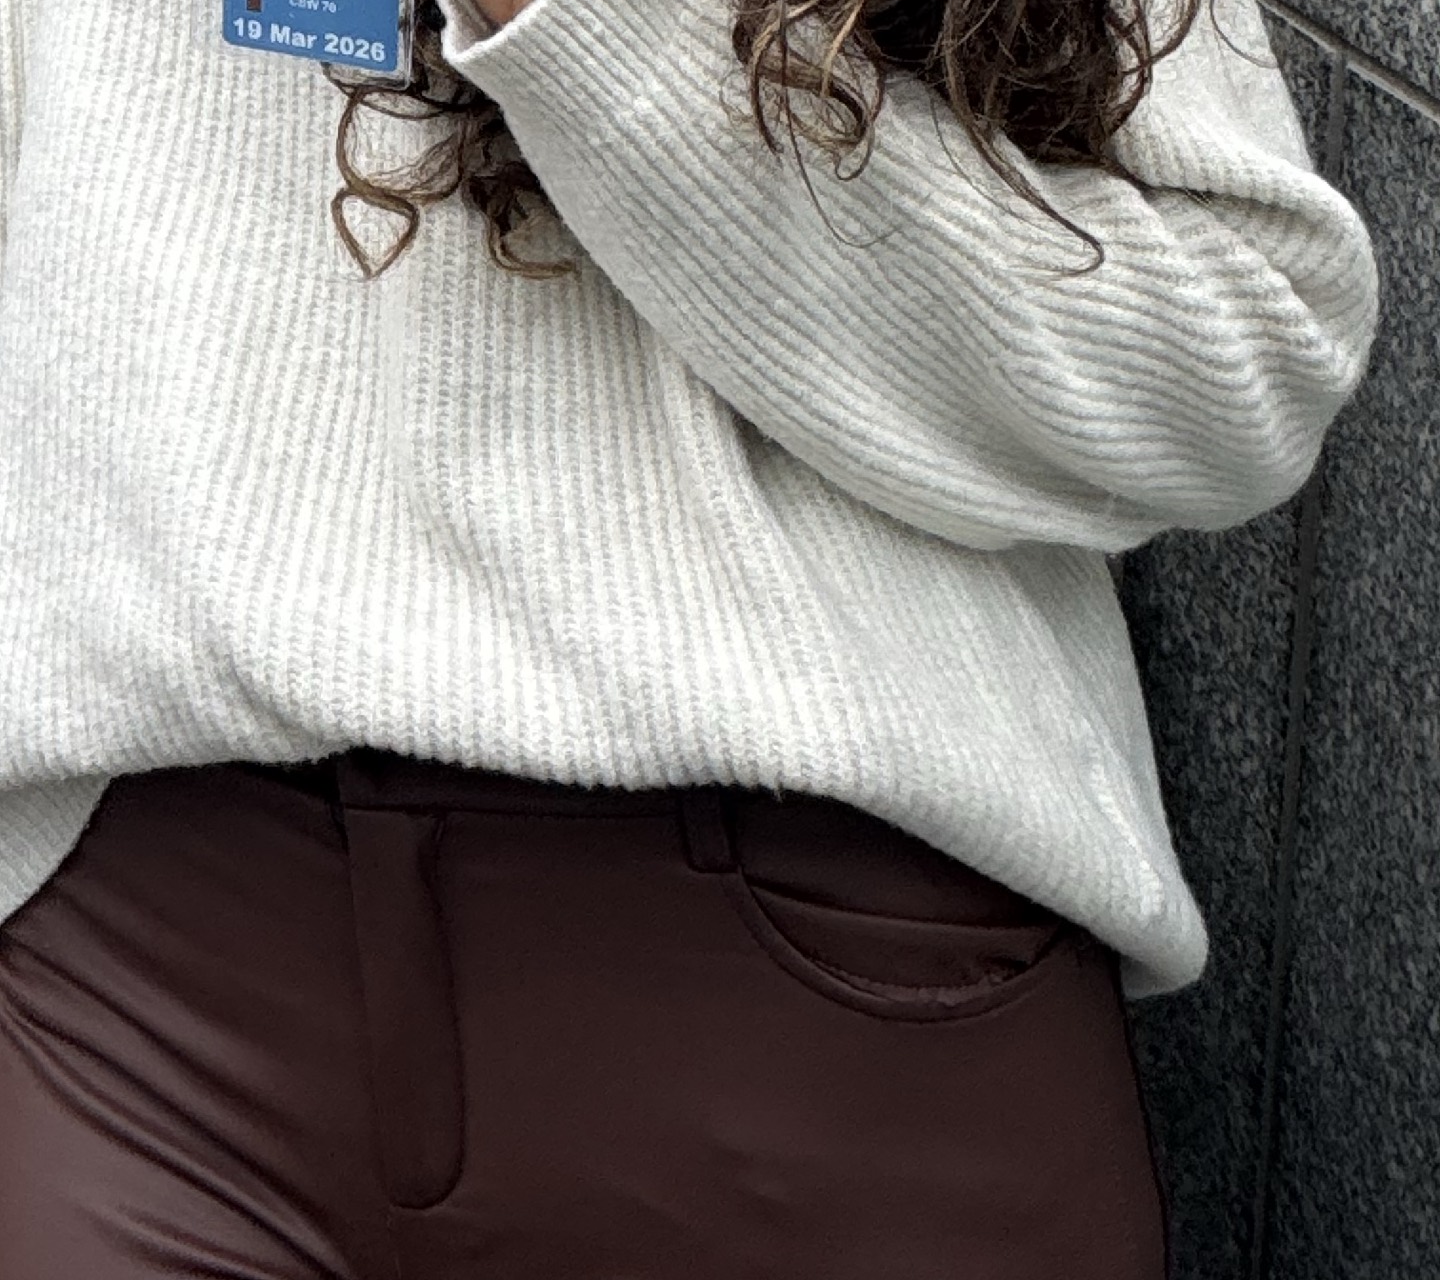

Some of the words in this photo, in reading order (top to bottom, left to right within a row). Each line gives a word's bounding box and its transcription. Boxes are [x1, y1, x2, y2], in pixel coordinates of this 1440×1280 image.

[233, 17, 262, 40] 19
[270, 23, 318, 49] Mar
[324, 32, 386, 63] 2026
